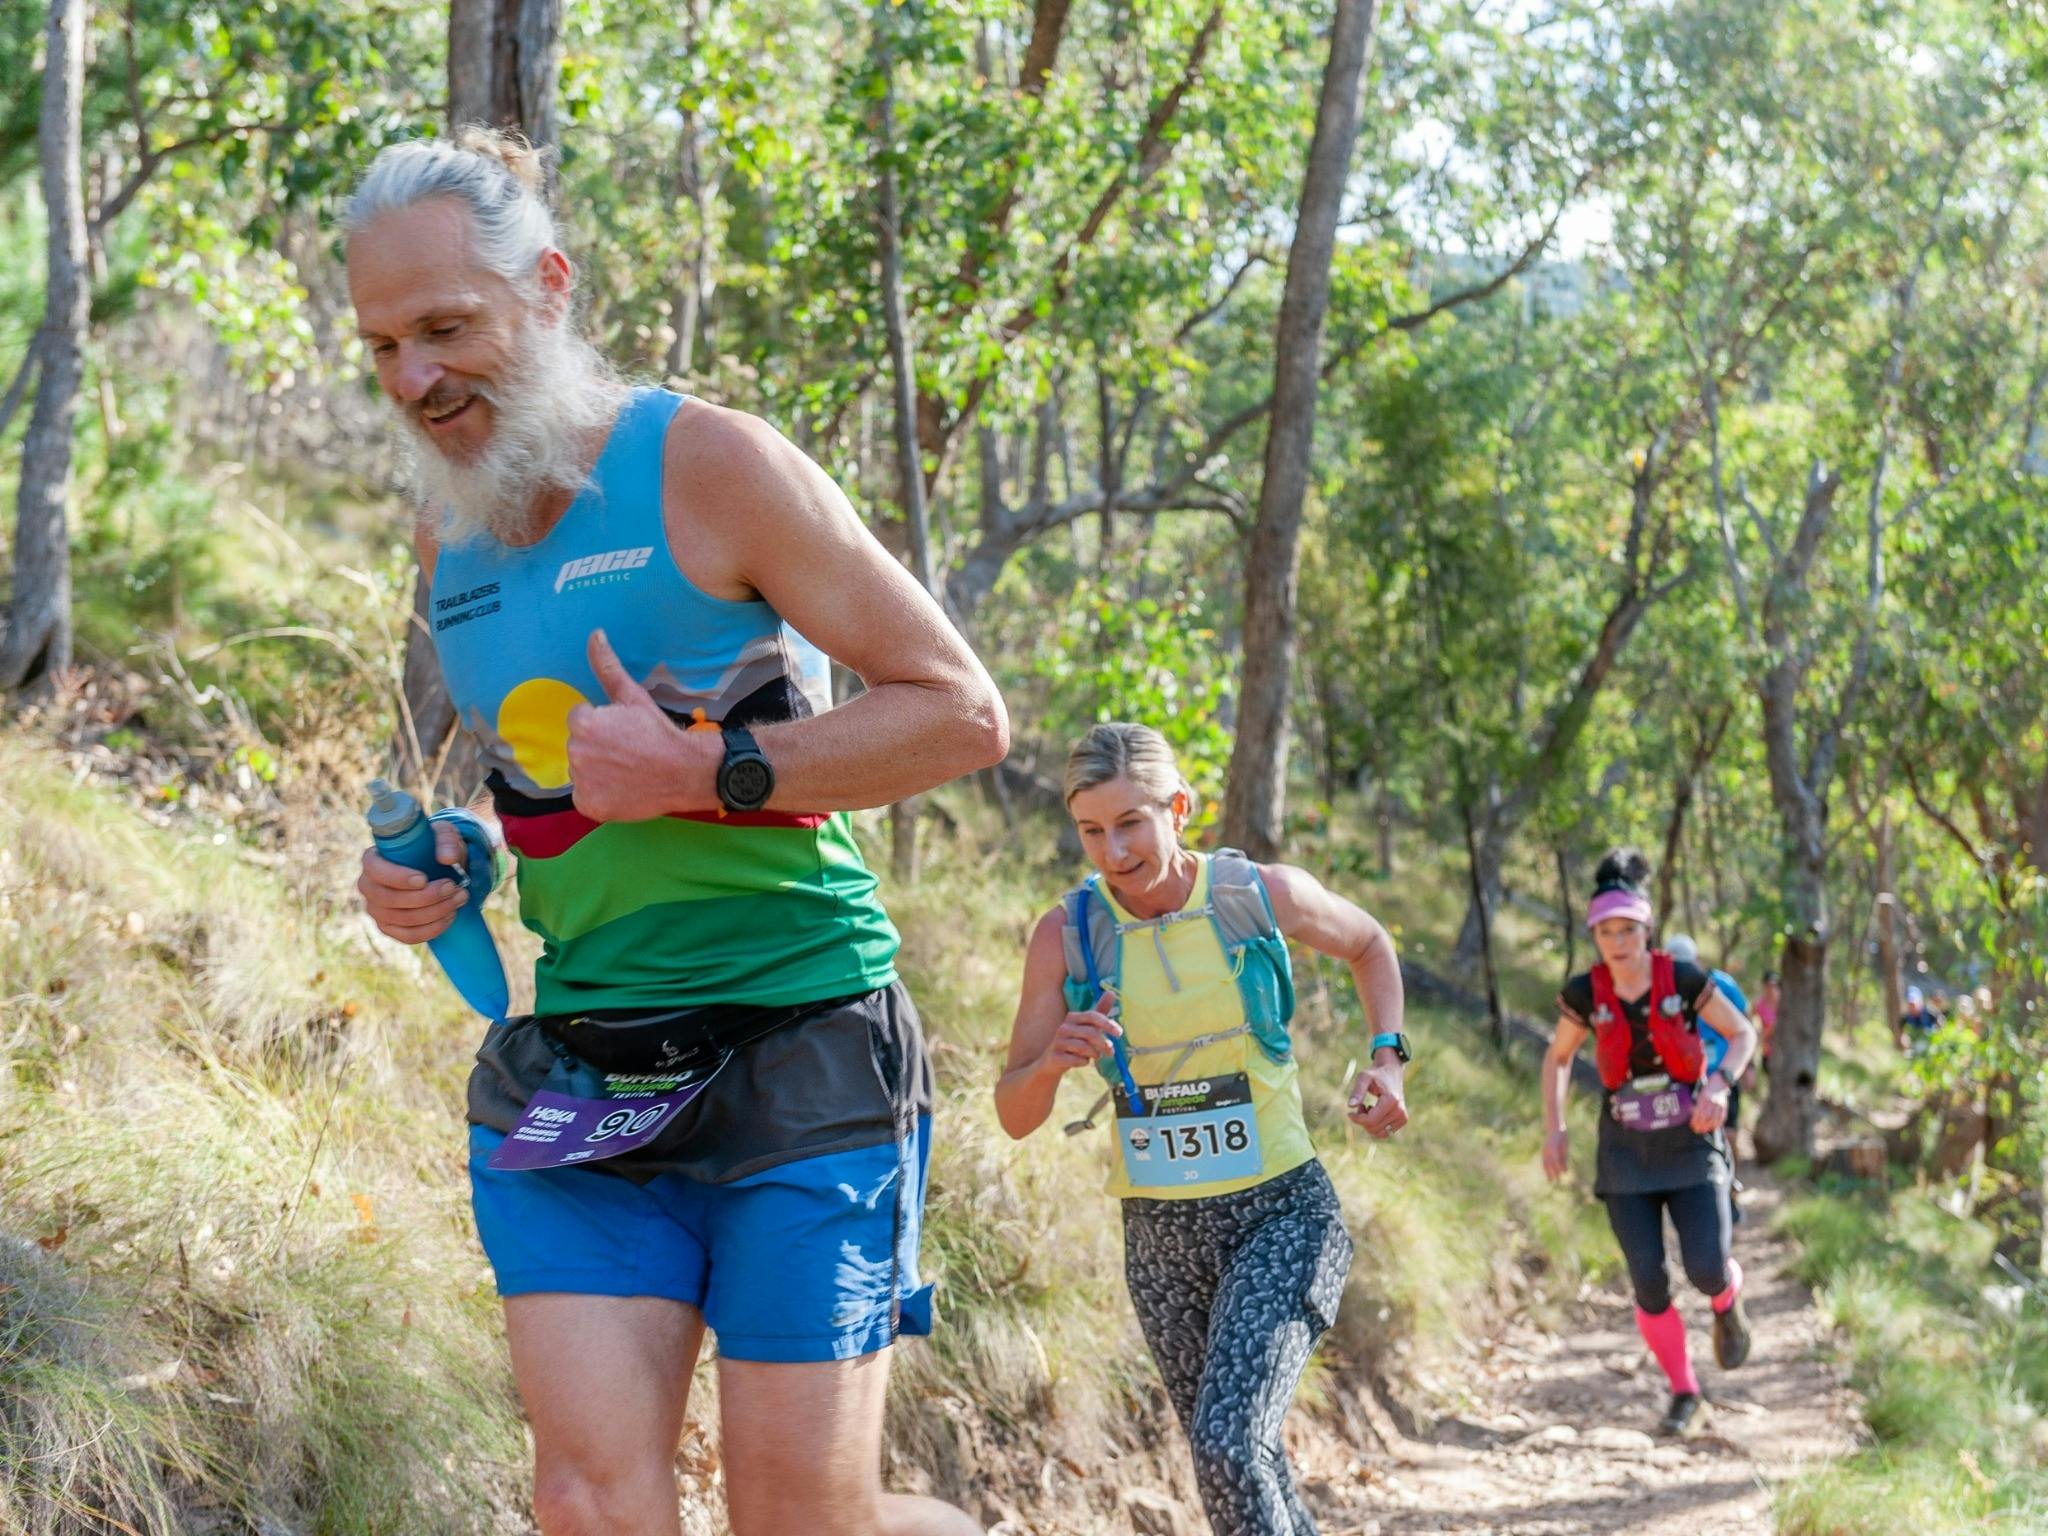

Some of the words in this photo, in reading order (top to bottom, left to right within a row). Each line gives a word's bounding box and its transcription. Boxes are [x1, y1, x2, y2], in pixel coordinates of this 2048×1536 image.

[567, 572, 631, 591] ATHLETIC
[435, 581, 501, 611] TRAILBLAZERS
[475, 600, 501, 617] CLUB
[1144, 1081, 1211, 1101] BUFFALO
[528, 1106, 578, 1124] HOKA
[584, 1102, 670, 1143] 90
[1159, 1119, 1249, 1161] 1318
